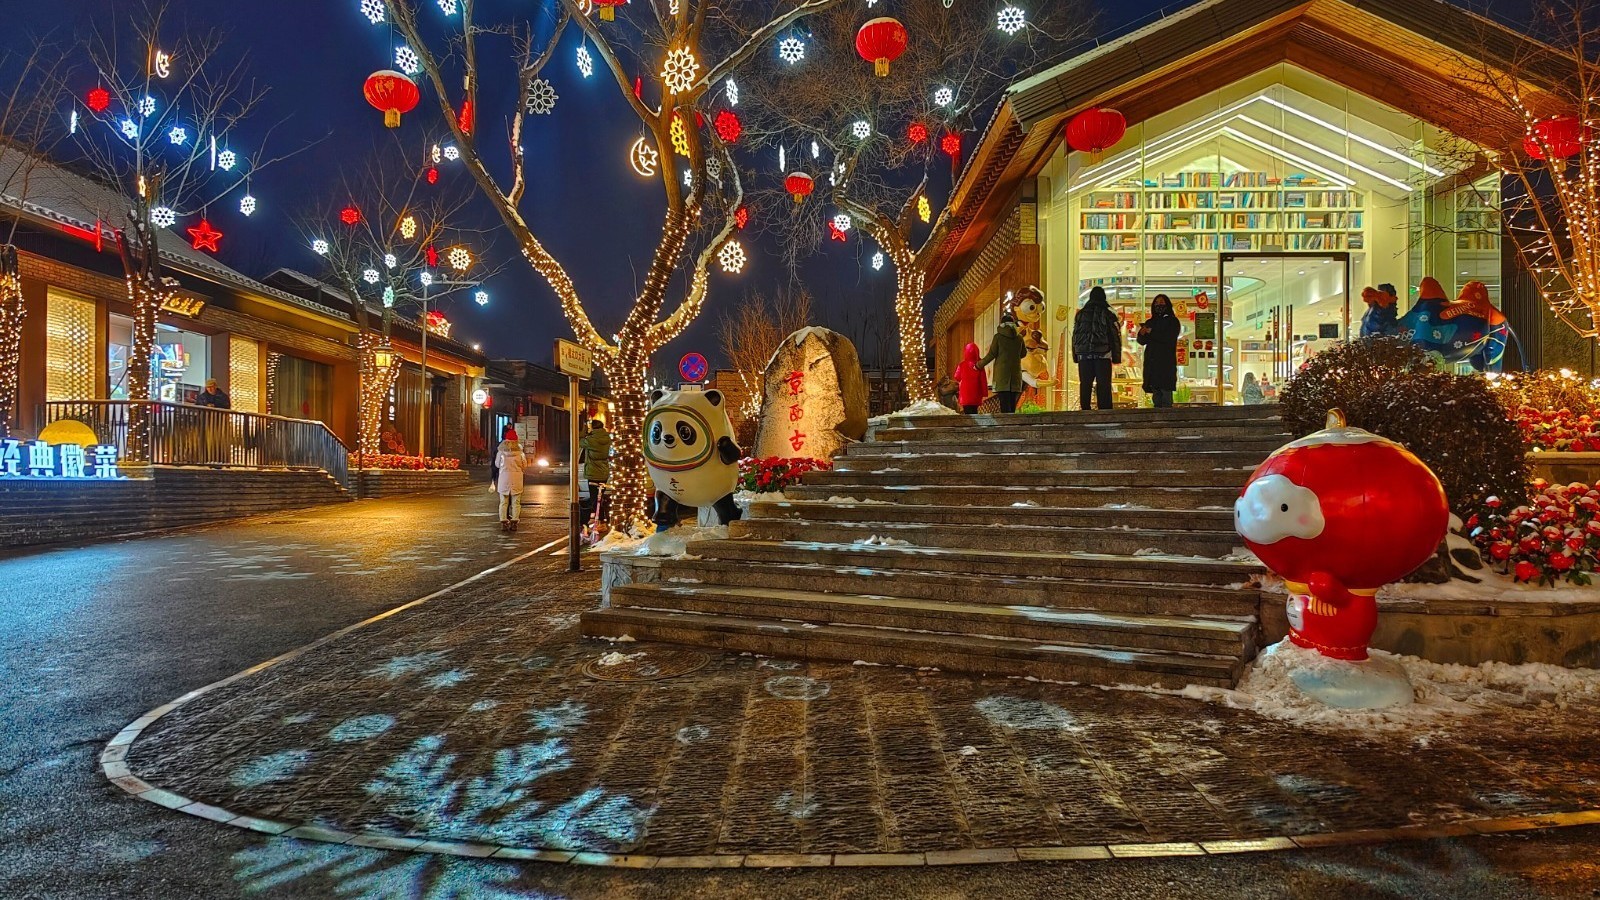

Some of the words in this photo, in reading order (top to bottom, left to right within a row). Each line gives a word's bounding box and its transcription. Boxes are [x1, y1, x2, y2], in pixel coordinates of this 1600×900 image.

[1446, 302, 1476, 318] BEIJING
[0, 439, 118, 478] 经典徽菜
